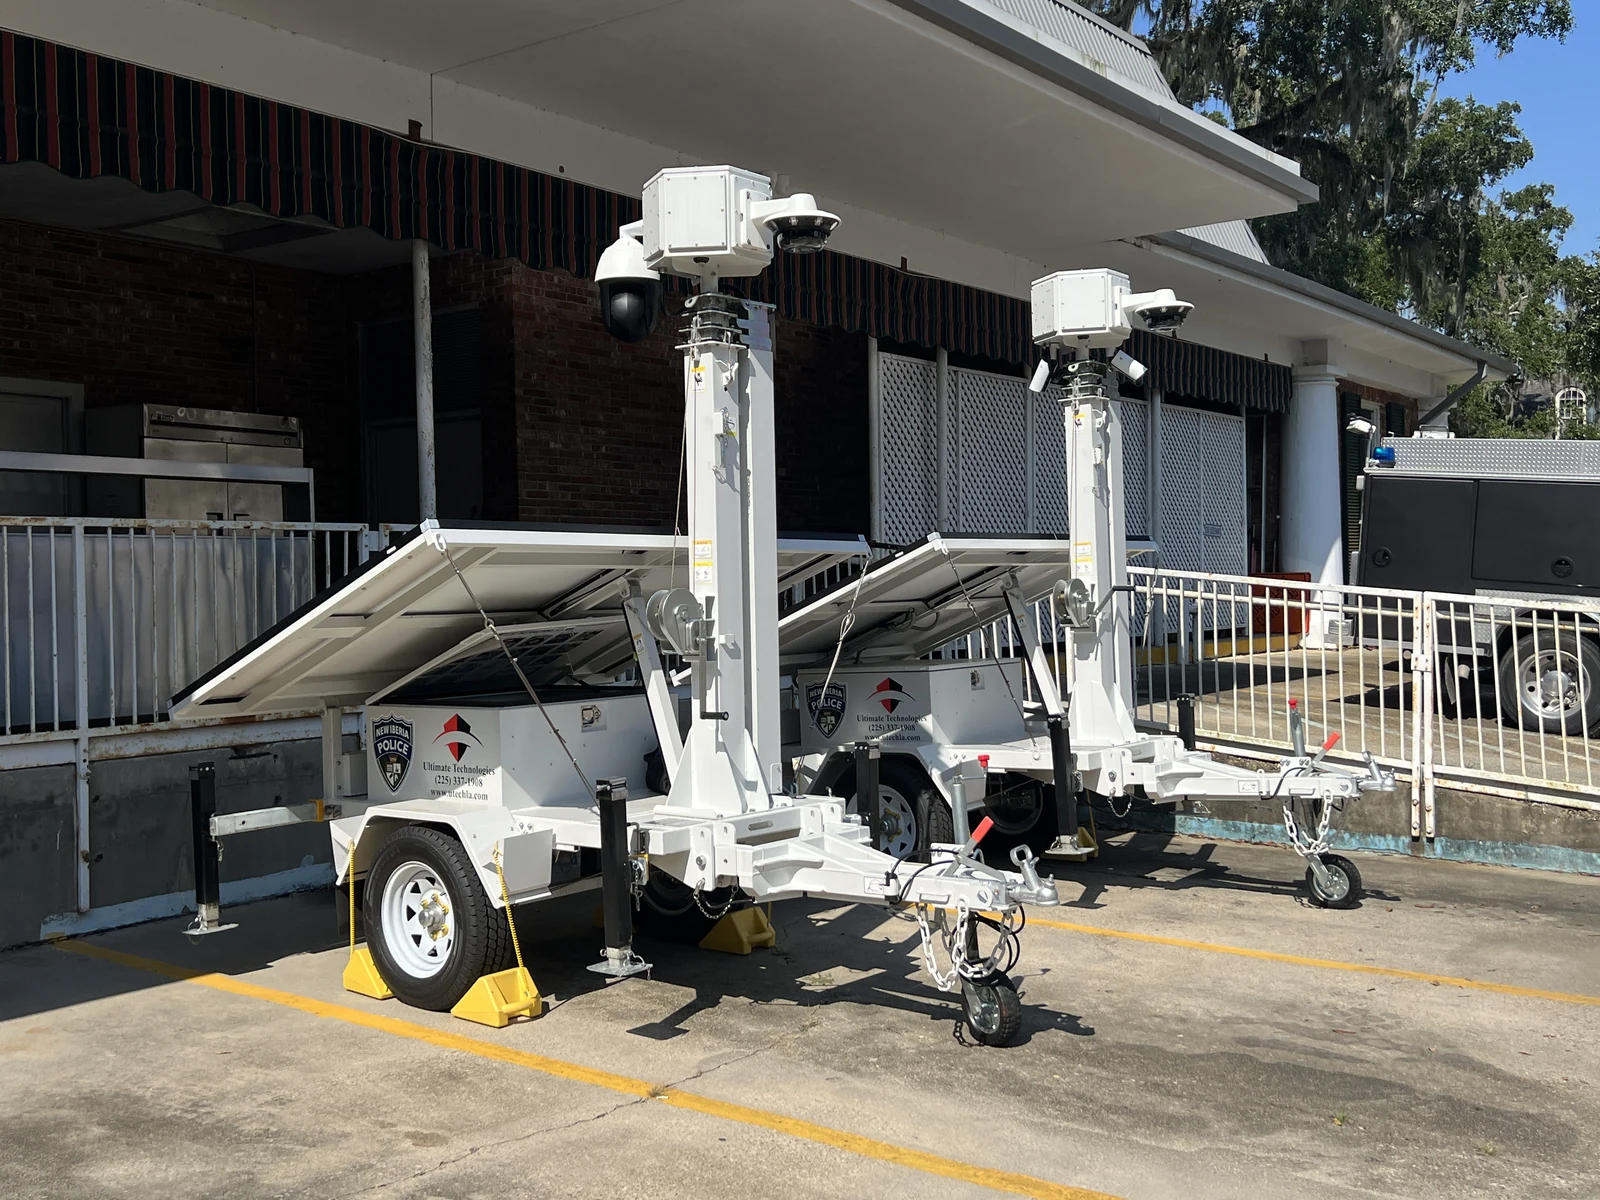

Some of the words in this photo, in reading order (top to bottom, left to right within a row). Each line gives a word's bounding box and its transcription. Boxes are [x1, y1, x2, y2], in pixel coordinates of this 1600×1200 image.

[809, 688, 823, 699] NEW
[824, 687, 843, 699] BERIA
[811, 698, 843, 711] POLICE
[886, 715, 928, 724] Technologies
[376, 725, 389, 737] NEW
[390, 724, 410, 740] IBERIA
[868, 724, 885, 732] (225)
[886, 724, 916, 732] 337-1908
[377, 739, 409, 756] POLICE
[422, 761, 451, 773] Ultimate
[452, 763, 496, 776] Technologies
[434, 775, 452, 786] (225)
[453, 776, 484, 788] 337-1908
[430, 788, 489, 801] www.utechla.com
